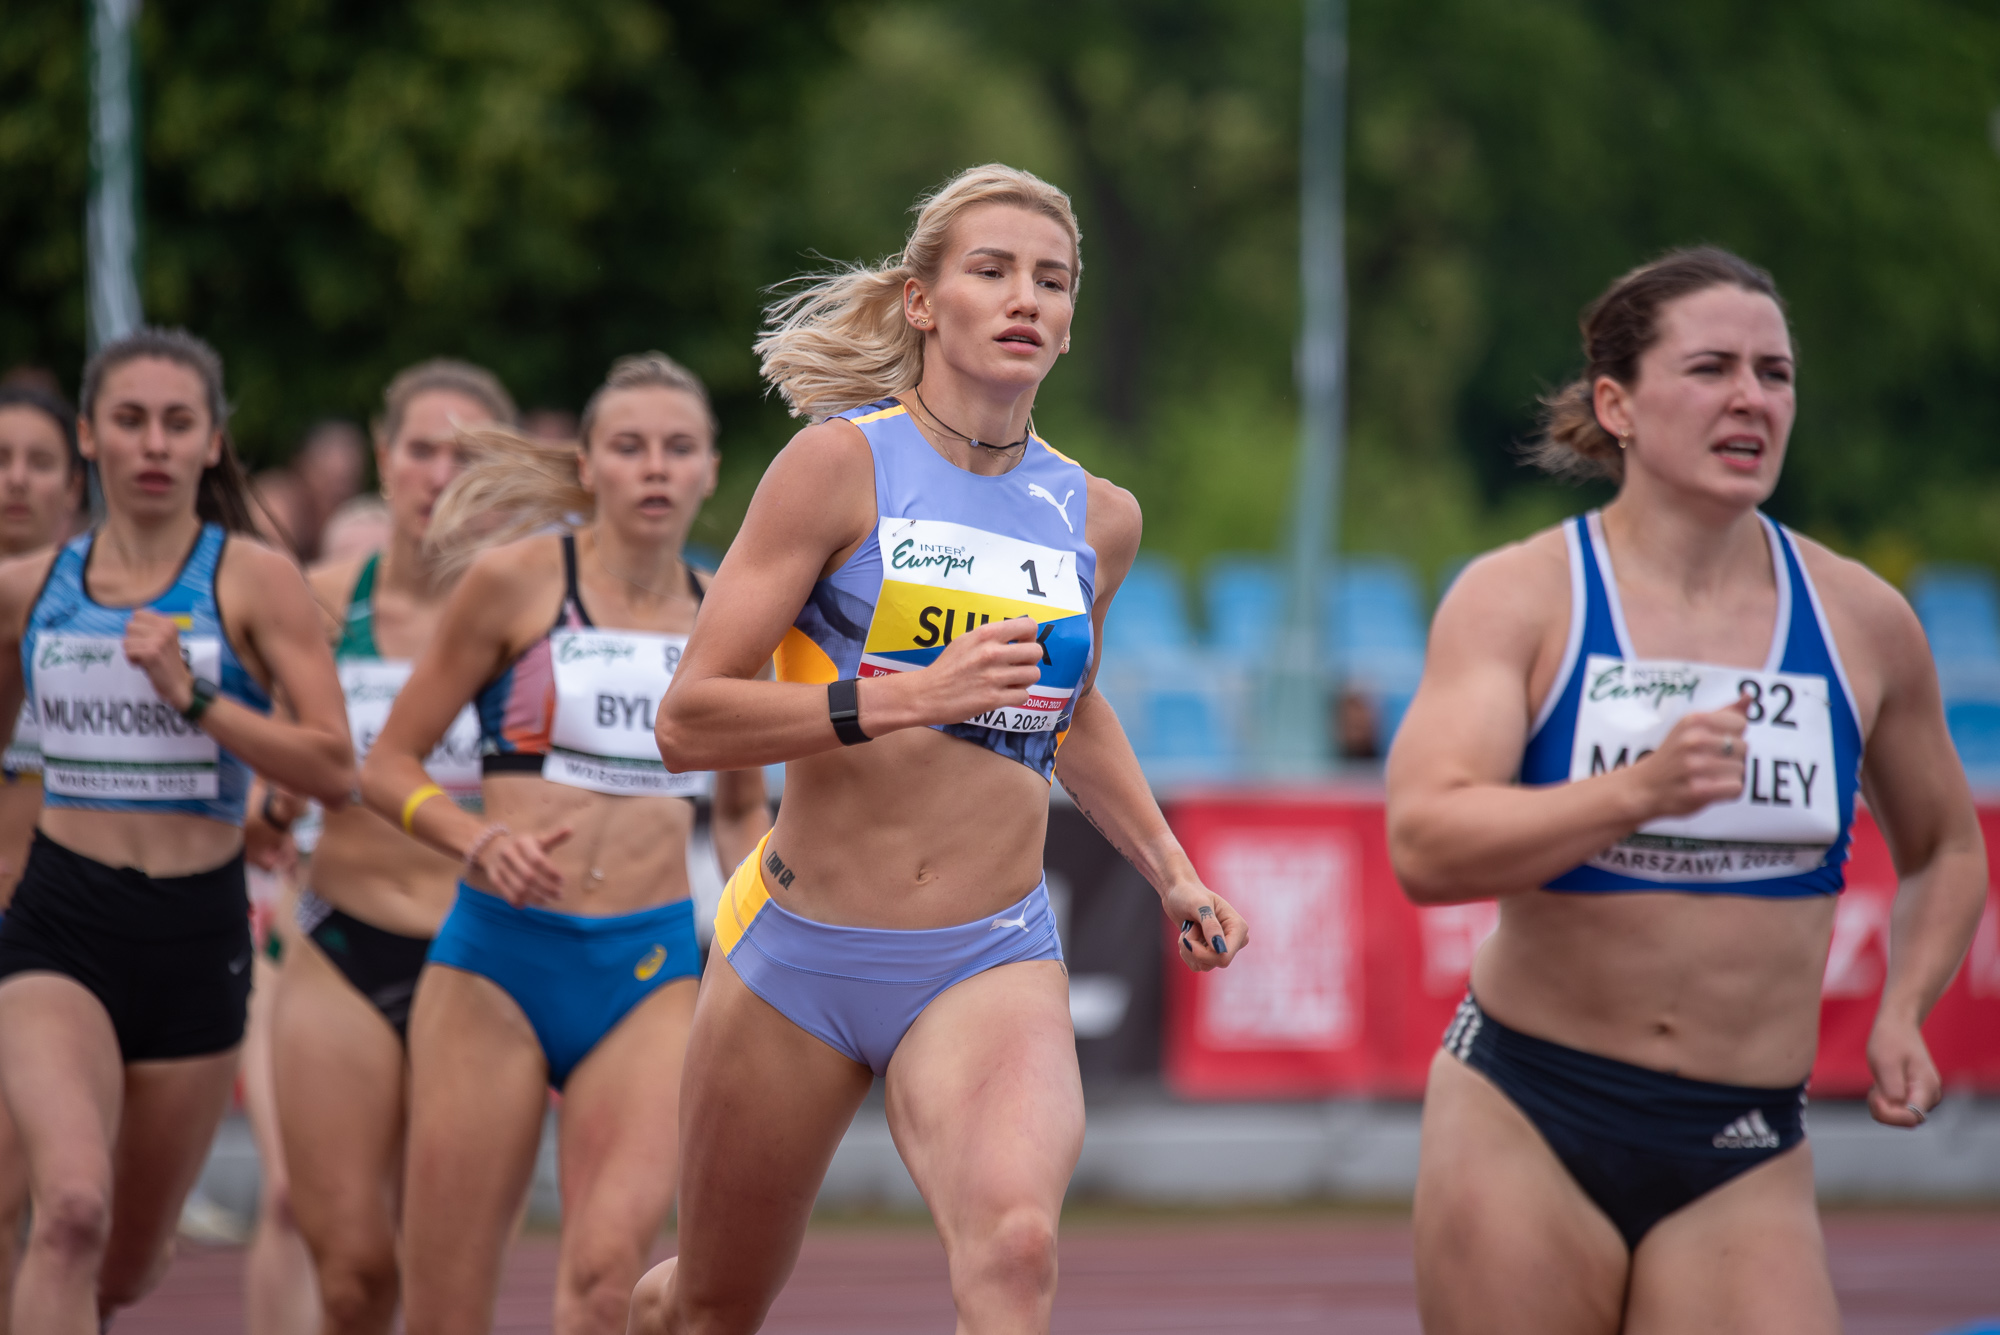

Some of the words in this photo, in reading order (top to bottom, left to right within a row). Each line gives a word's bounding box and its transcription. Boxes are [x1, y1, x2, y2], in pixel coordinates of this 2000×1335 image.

[891, 538, 975, 577] Europol
[920, 544, 961, 556] INTER
[1019, 559, 1047, 597] 1
[912, 606, 1055, 666] SUK
[1630, 668, 1684, 682] NTER
[42, 698, 204, 735] MUKHOBRO
[1012, 713, 1048, 730] 2023
[1022, 698, 1049, 708] OJACH
[1738, 679, 1798, 730] 82
[1590, 745, 1818, 807] MLEY
